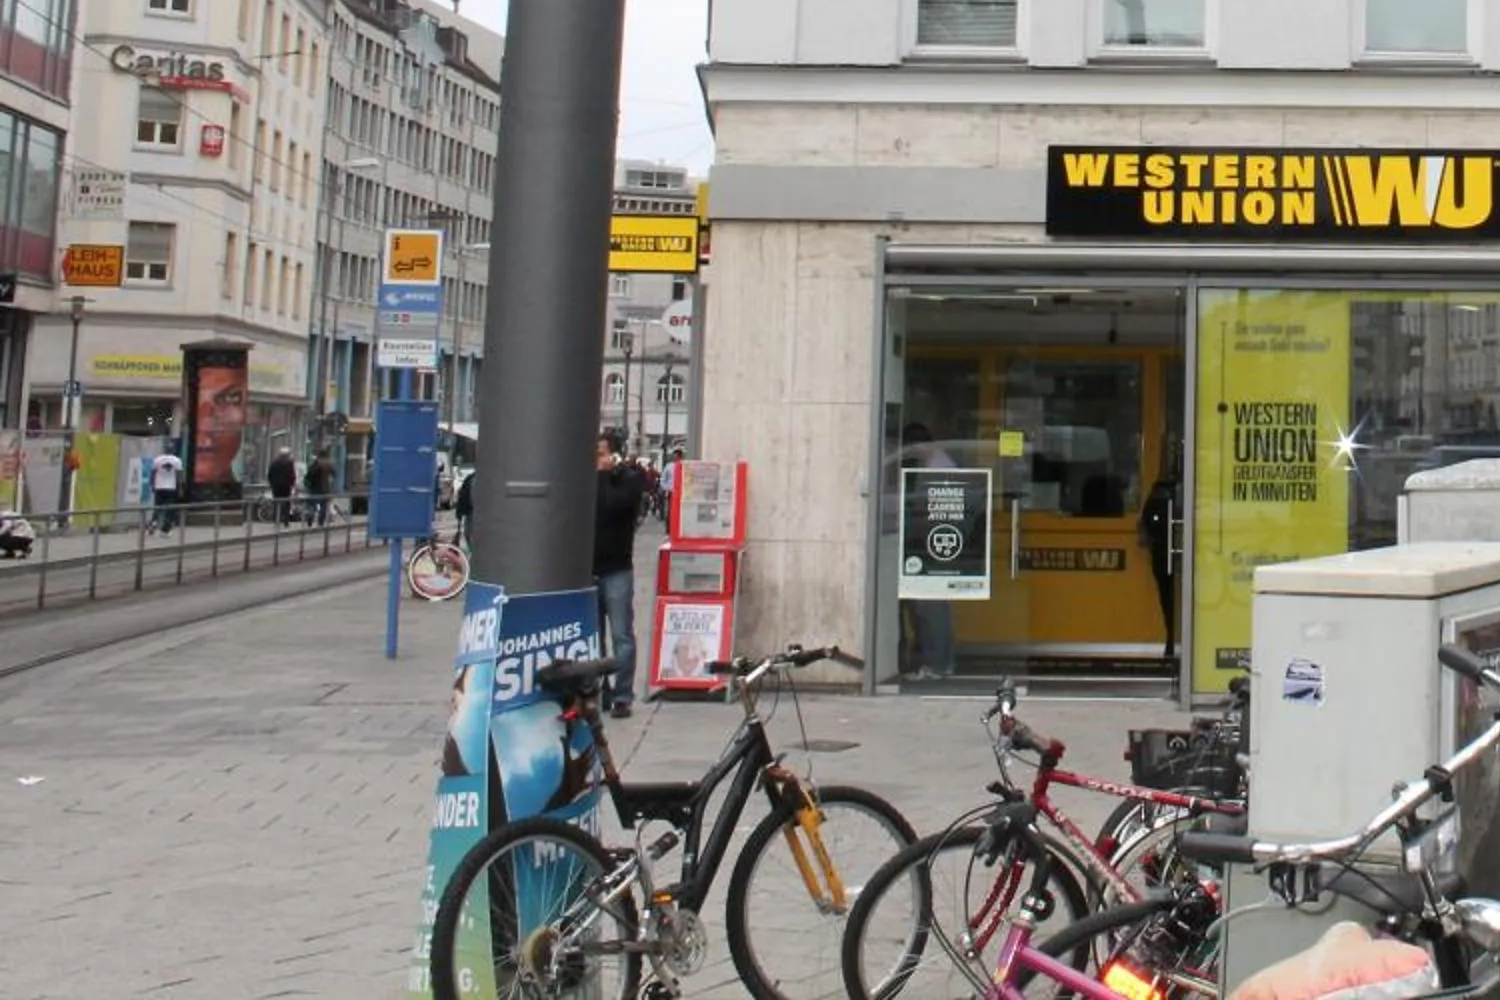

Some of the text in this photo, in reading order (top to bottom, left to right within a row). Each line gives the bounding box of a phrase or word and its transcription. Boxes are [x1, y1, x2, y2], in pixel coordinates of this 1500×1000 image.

[111, 45, 225, 81] Caritas
[1063, 153, 1493, 228] WESTERN WU
[1142, 191, 1315, 226] UNION
[70, 263, 114, 277] HAUS
[71, 249, 117, 262] LEIH-
[1233, 402, 1317, 426] WESTERN
[1234, 428, 1317, 463] UNION
[1233, 465, 1317, 480] GELDTRANSFER
[1233, 482, 1317, 501] IN MINUTEN
[498, 621, 582, 656] JOHANNES
